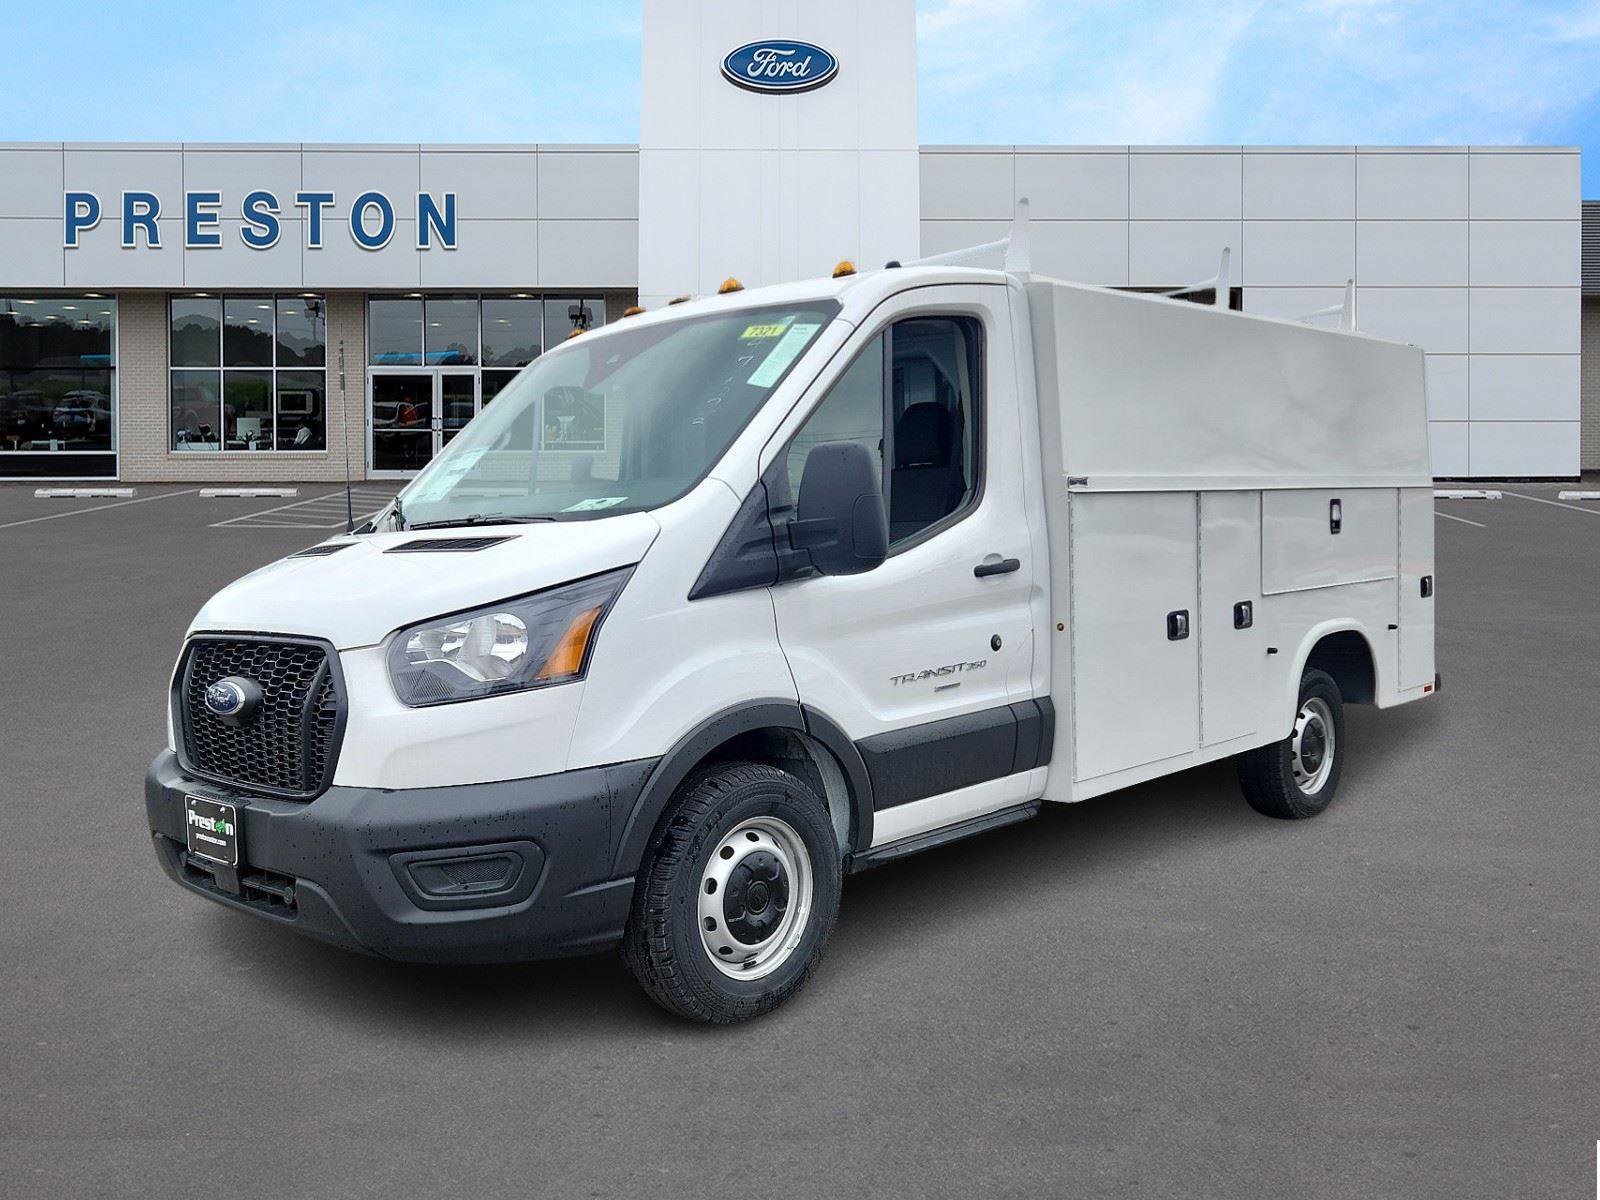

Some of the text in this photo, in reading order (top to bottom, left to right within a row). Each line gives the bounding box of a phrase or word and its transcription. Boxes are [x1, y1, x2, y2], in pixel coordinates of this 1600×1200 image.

[747, 48, 811, 77] Ford
[63, 189, 458, 250] PRESTON
[889, 662, 967, 686] TRANSIT
